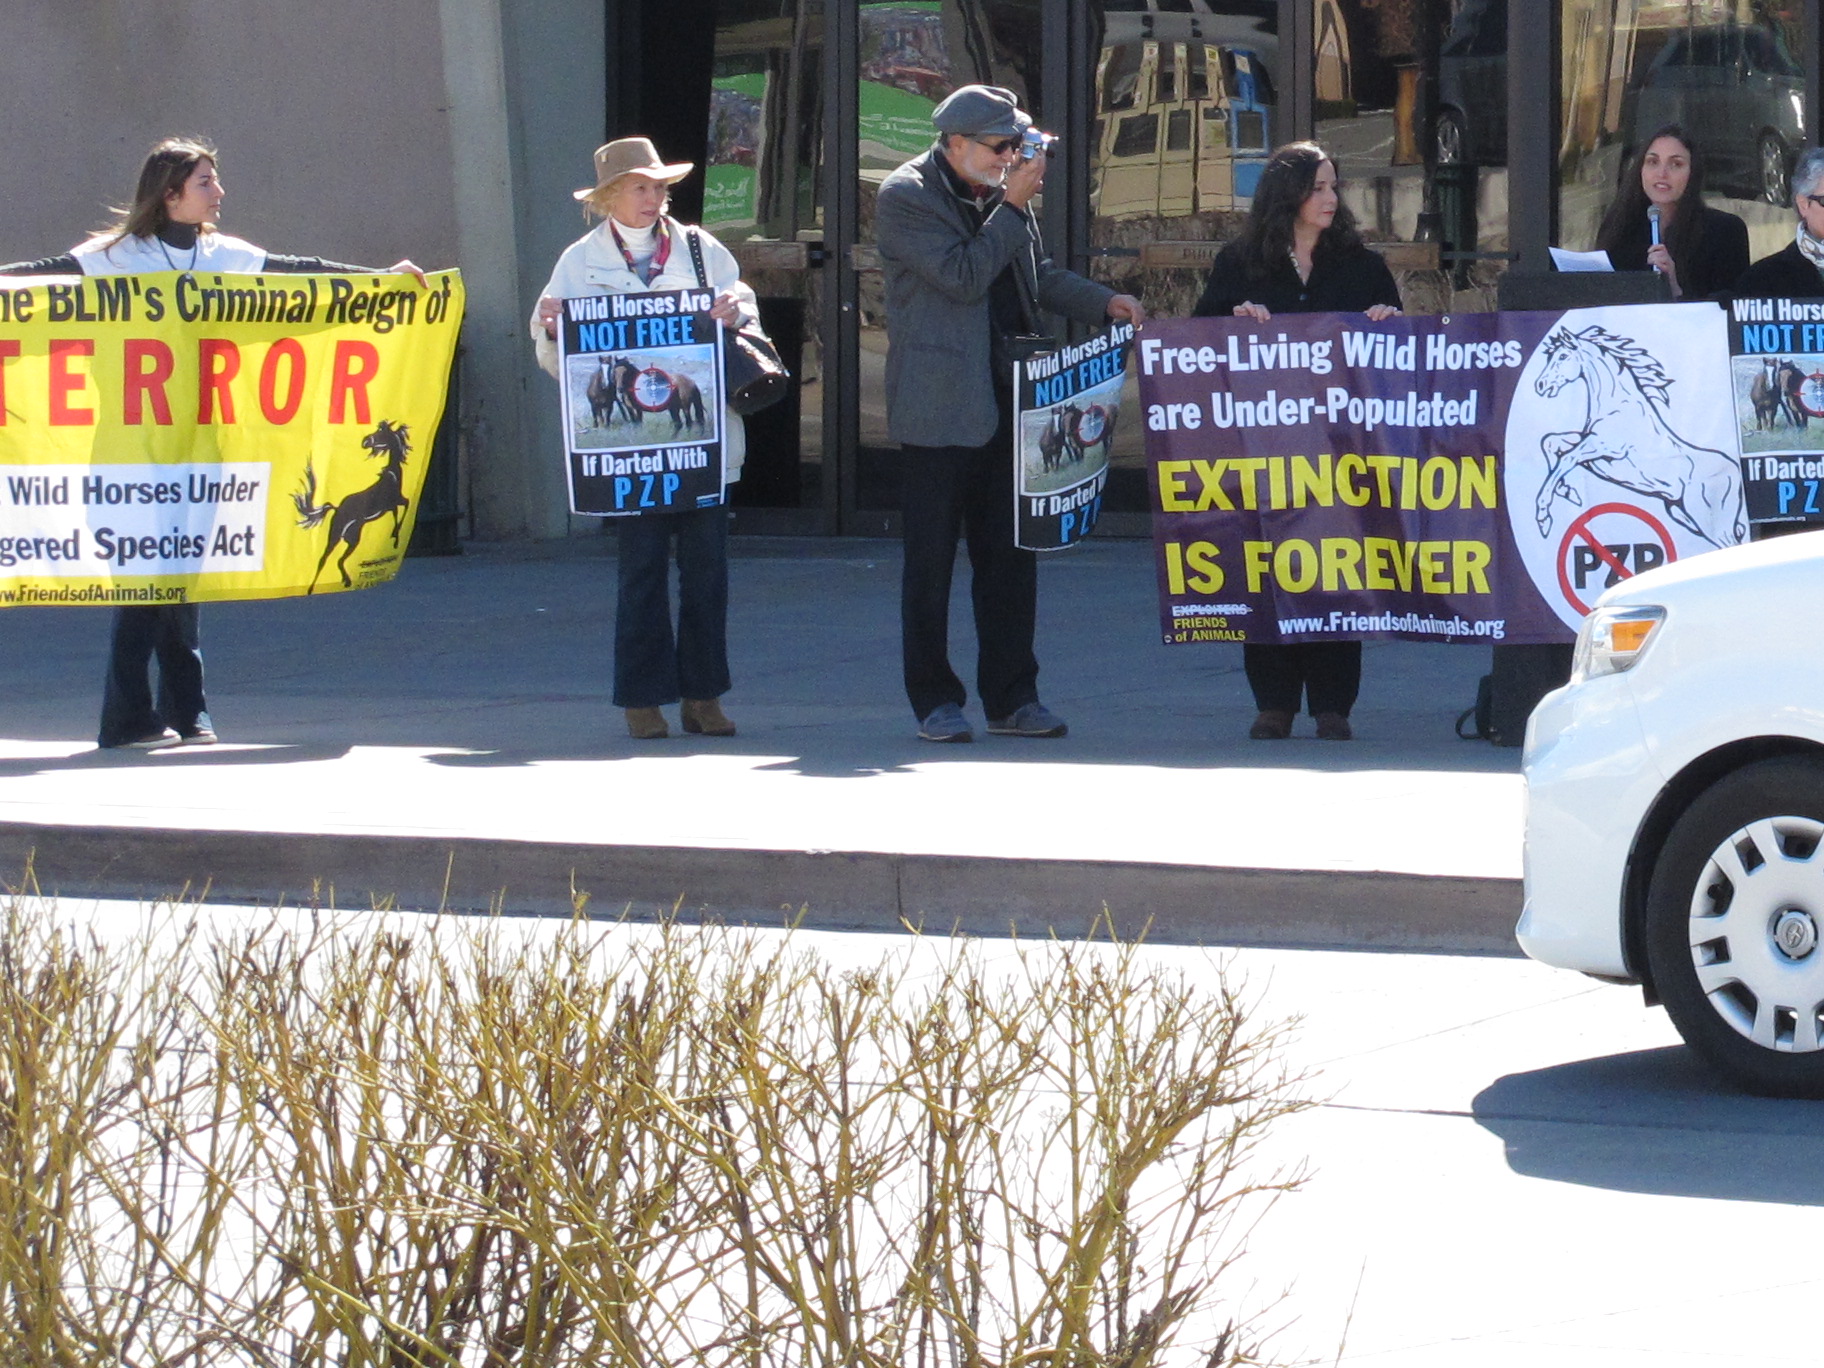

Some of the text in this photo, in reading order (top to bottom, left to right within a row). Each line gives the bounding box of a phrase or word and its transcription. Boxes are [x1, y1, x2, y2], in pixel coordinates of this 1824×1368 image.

[47, 277, 165, 322] BLM's
[176, 275, 316, 323] Criminal
[325, 278, 415, 334] Reign
[425, 276, 452, 324] of
[569, 290, 711, 322] Wild Horses Are
[1732, 299, 1774, 322] Wild
[578, 315, 695, 352] NOT FREE
[1026, 323, 1134, 381] Wild Horses Are
[1743, 324, 1794, 353] NOT
[1141, 331, 1522, 375] Free-Living Wild Horses
[1035, 347, 1123, 408] NOT FREE
[1148, 387, 1478, 432] are Under-Populated
[582, 446, 707, 476] If Darted With
[1748, 459, 1761, 481] If
[8, 474, 260, 505] Wild Horses Under
[1031, 496, 1046, 516] If
[1050, 479, 1096, 514] Darted
[1157, 453, 1497, 513] EXTINCTION
[94, 527, 204, 565] Species
[211, 525, 255, 557] Act
[1165, 536, 1492, 595] IS FOREVER
[1173, 617, 1228, 630] FRIENDS
[1175, 629, 1246, 642] of ANIMALS
[1278, 611, 1505, 640] www.FriendsofAnimals.org
